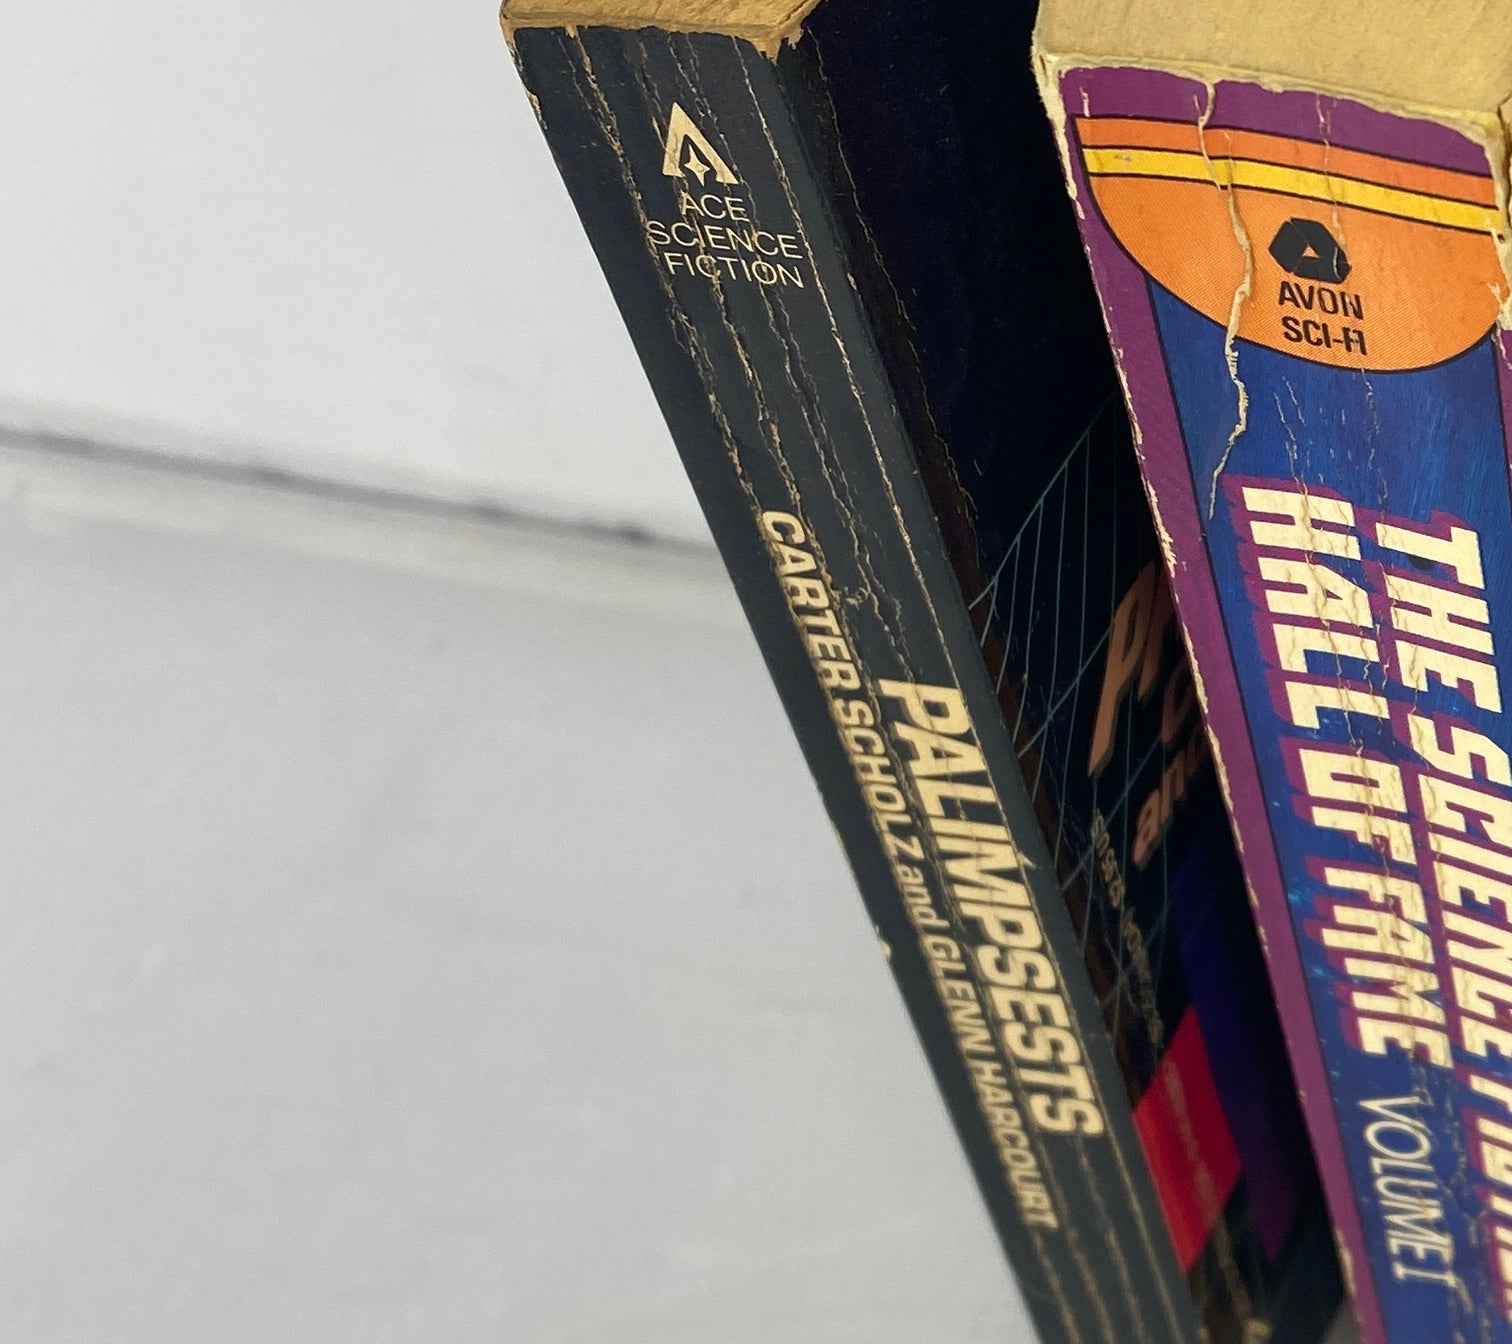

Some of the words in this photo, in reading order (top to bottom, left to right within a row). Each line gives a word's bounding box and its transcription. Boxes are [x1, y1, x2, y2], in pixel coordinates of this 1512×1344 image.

[647, 218, 804, 261] SCIENCE
[663, 251, 805, 289] FICTION
[680, 193, 750, 223] ACE
[1277, 279, 1365, 321] AVON
[1280, 314, 1368, 357] SCI-FI
[761, 509, 862, 692] CARTER
[1241, 485, 1391, 730] HALL
[1375, 520, 1503, 714] THE
[831, 697, 926, 862] SCHOLZ
[1298, 747, 1417, 866] OF
[877, 677, 1105, 1136] PALIMPSESTS
[895, 863, 950, 929] and
[919, 933, 998, 1057] GLENN
[1320, 865, 1455, 1070] FAME
[969, 1059, 1059, 1230] HARCOURT
[1358, 1094, 1455, 1265] VOLUME
[1392, 1260, 1457, 1288] I
